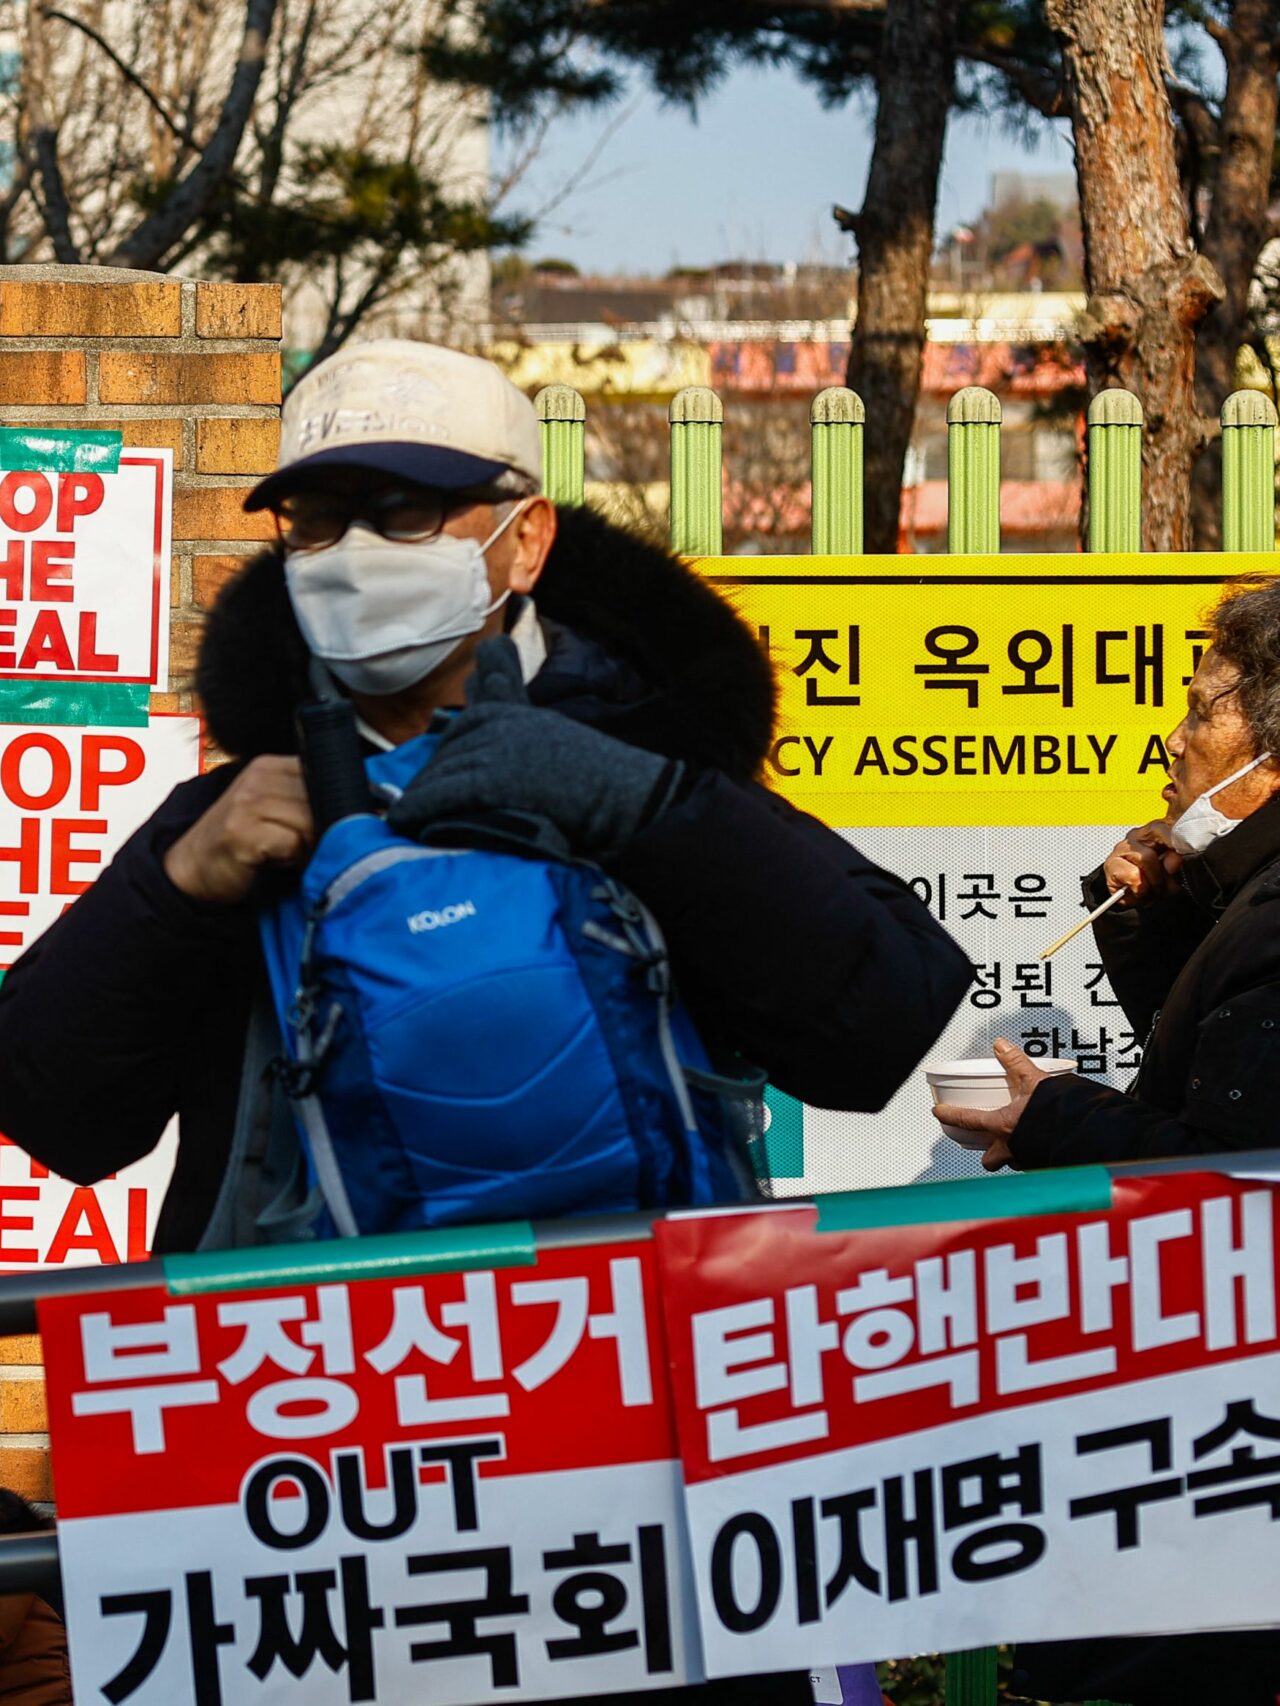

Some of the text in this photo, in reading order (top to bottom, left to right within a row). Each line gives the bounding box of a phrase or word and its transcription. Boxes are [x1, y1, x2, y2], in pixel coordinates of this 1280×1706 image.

[759, 624, 861, 706] 진
[854, 733, 1118, 776] ASSEMBLY
[407, 900, 476, 934] KOLON
[908, 873, 1053, 920] 이곳은
[72, 1256, 653, 1455] 부정선거
[690, 1189, 1277, 1462] 탄핵반대
[241, 1434, 506, 1550] OUT
[710, 1398, 1280, 1635] 이재명 구속
[100, 1523, 674, 1706] 가짜국회
